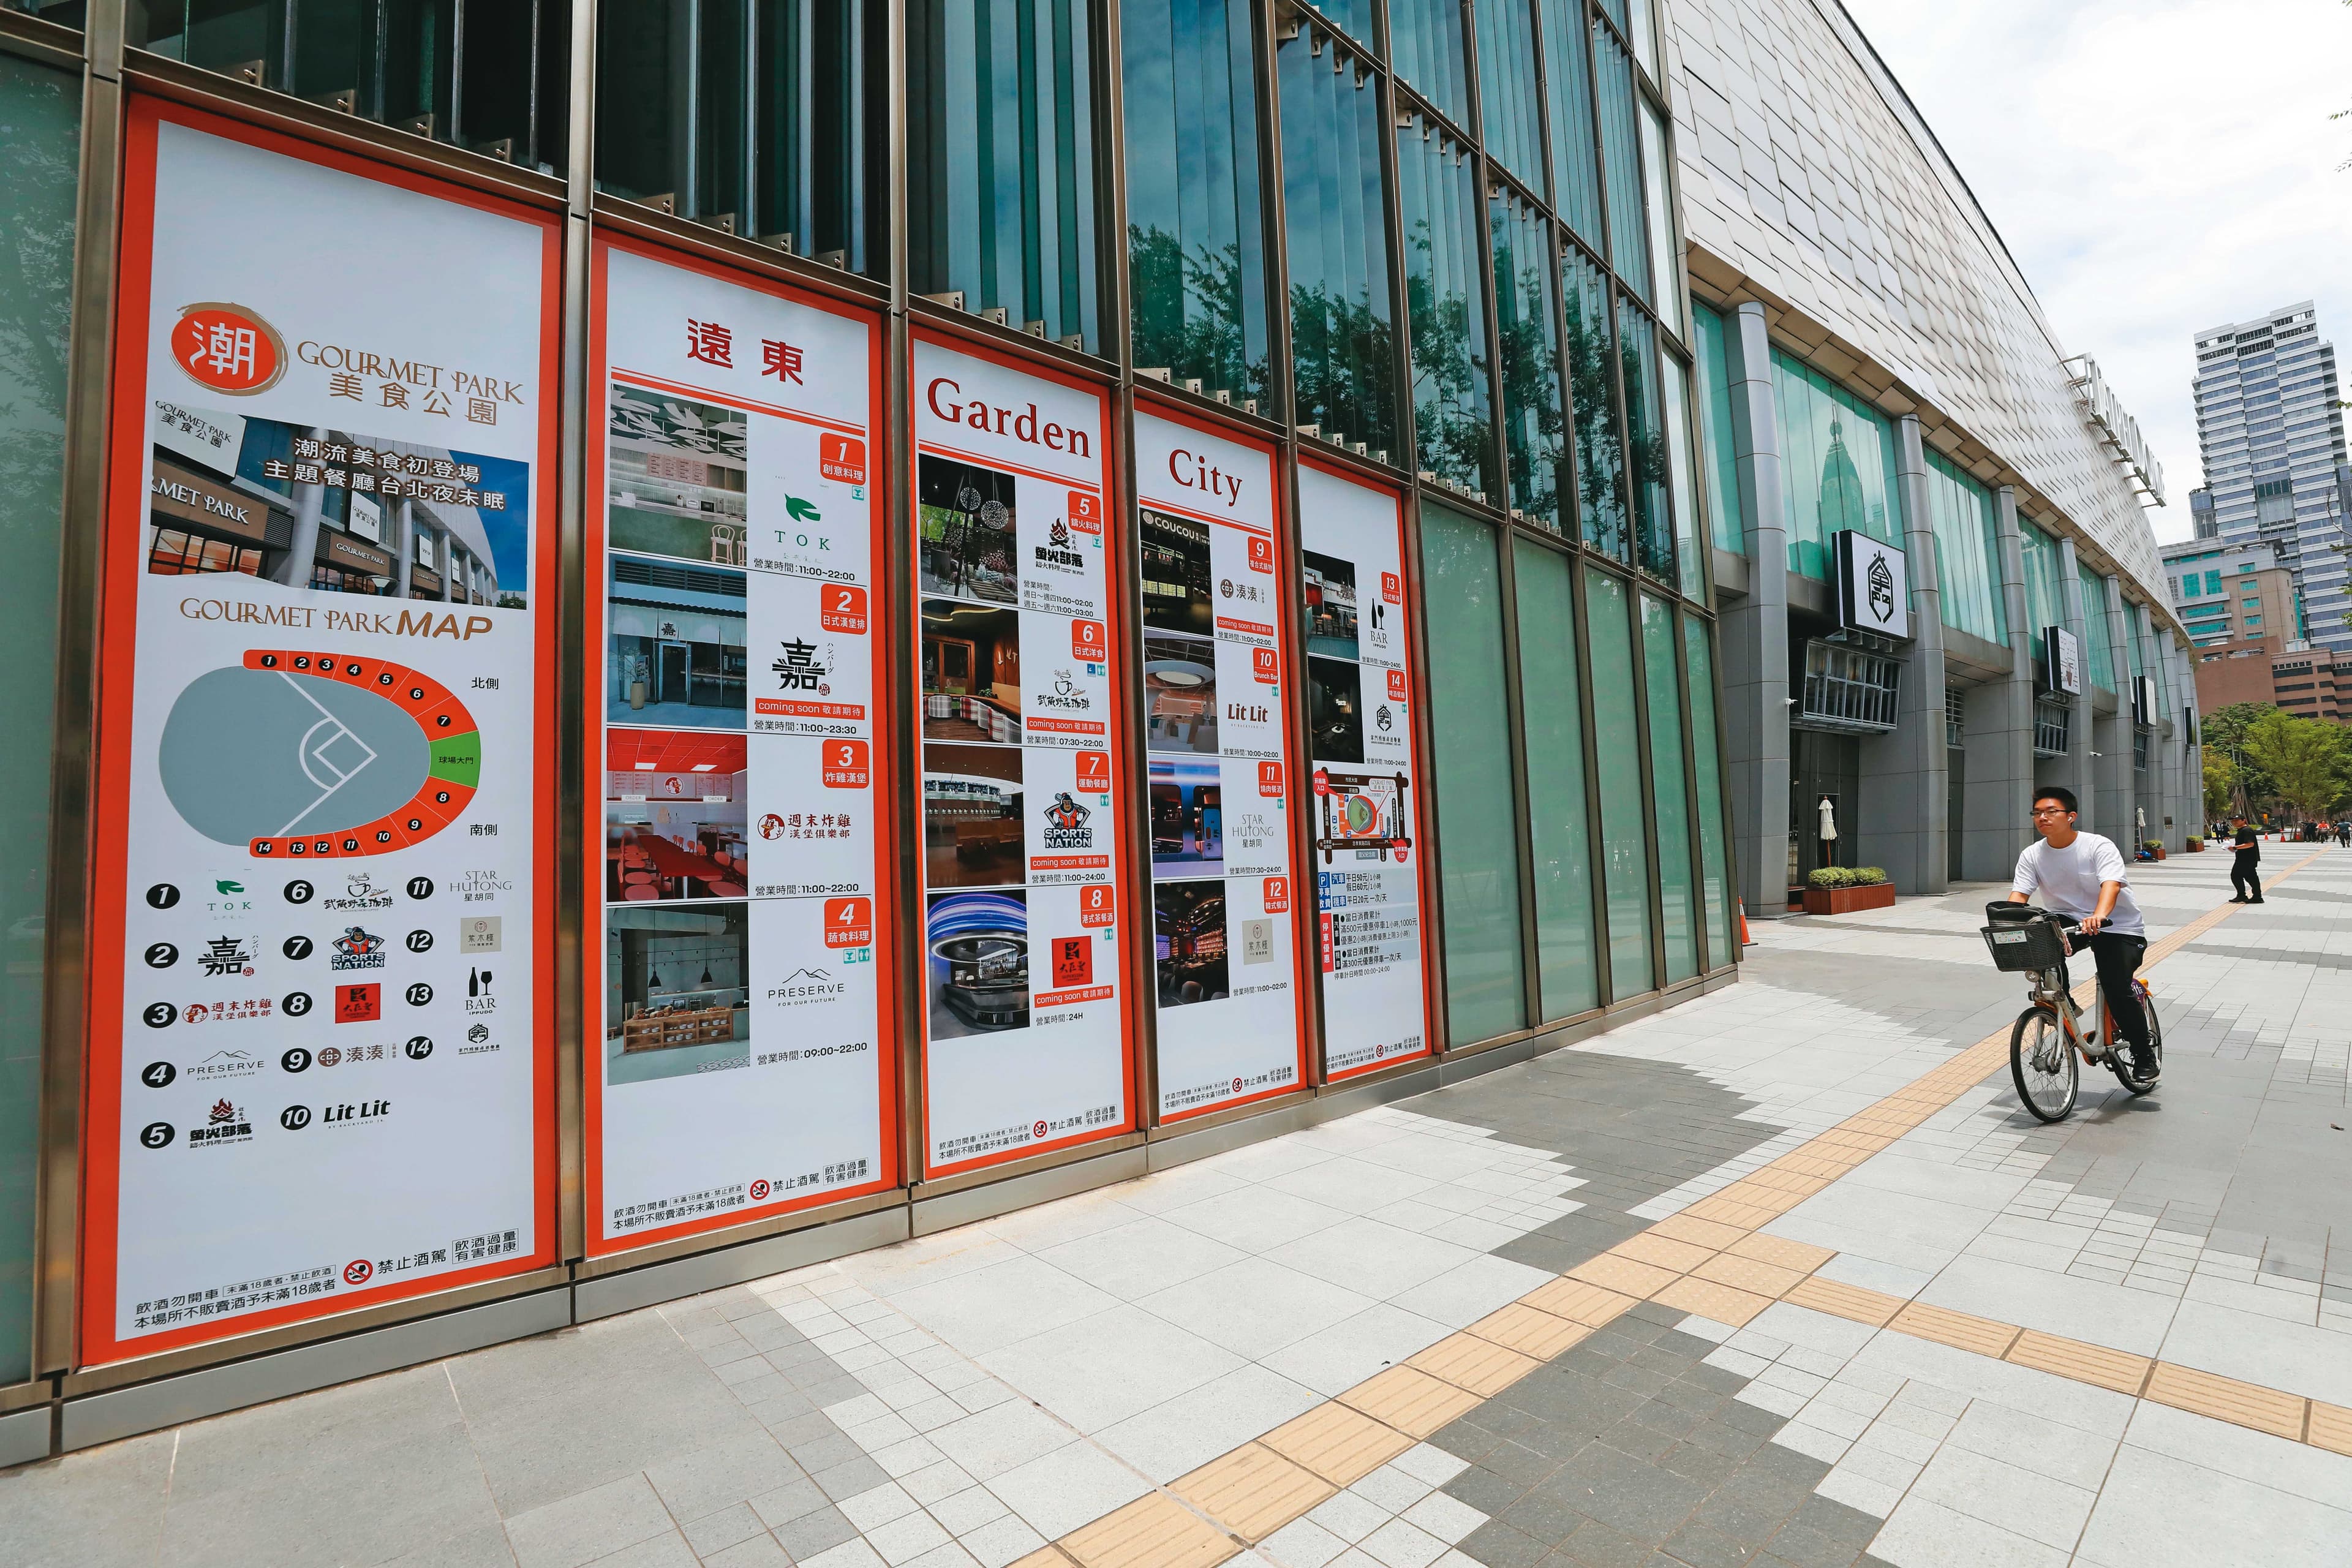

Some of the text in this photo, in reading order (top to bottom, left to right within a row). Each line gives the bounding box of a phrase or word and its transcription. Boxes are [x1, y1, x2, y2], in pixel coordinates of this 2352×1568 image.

[191, 321, 256, 380] 潮
[687, 318, 804, 386] 遠東
[297, 341, 524, 405] GOURMET PARK
[329, 372, 497, 425] 美食公園
[156, 401, 232, 443] GOURMET PARK
[927, 377, 1091, 459] Garden
[161, 413, 222, 448] 美食公園
[295, 438, 480, 483] 潮流美食初登場
[839, 442, 848, 462] 1
[823, 462, 863, 481] 創意料理
[1169, 449, 1242, 507] City
[265, 461, 504, 510] 主題餐廳台北夜未眠
[204, 493, 249, 526] PARK
[1079, 498, 1090, 515] 5
[1155, 517, 1194, 539] COUCOU
[775, 530, 830, 551] TOK
[336, 543, 385, 565] GOURMET PARK
[1035, 546, 1084, 568] 螢火部落
[1256, 542, 1264, 557] 9
[1387, 577, 1395, 589] 13
[836, 591, 853, 611] 2
[1236, 584, 1257, 601] 湊湊
[180, 598, 493, 641] GOURMET PARK MAP
[823, 615, 865, 630] 日式漢堡排
[1218, 620, 1237, 628] coming
[661, 622, 676, 636] 嘉
[1083, 625, 1093, 642] 6
[1370, 631, 1388, 644] BAR
[1075, 646, 1103, 658] 日式洋食
[1260, 652, 1272, 666] 10
[772, 636, 826, 690] 嘉
[471, 677, 499, 690] 北側
[1392, 674, 1400, 687] 14
[759, 701, 794, 714] coming
[823, 706, 861, 716] 敬請期待
[1227, 703, 1268, 722] Lit Lit
[1029, 720, 1054, 729] coming
[1074, 722, 1102, 732] 敬請期待
[438, 756, 474, 764] 球場大門
[838, 745, 853, 767] 3
[1089, 756, 1100, 774] 7
[1266, 766, 1275, 780] 11
[825, 772, 867, 783] 炸雞漢堡
[1079, 778, 1108, 788] 運動餐廳
[788, 813, 851, 827] 週末炸雞
[1242, 814, 1264, 825] STAR
[470, 824, 497, 836] 南側
[790, 829, 850, 839] 漢堡俱樂部
[1044, 828, 1092, 838] SPORTS
[1232, 826, 1273, 837] HUTONG
[1045, 837, 1092, 848] NATION
[1243, 839, 1262, 848] 星胡同
[1033, 859, 1058, 867] coming
[1078, 857, 1106, 865] 敬請期待
[465, 870, 498, 881] STAR
[292, 883, 307, 900] 6
[413, 881, 428, 895] 11
[450, 881, 512, 892] HUTONG
[1270, 882, 1281, 897] 12
[159, 887, 168, 904] 1
[464, 893, 494, 902] 星胡同
[1091, 889, 1102, 907] 8
[207, 902, 252, 911] TOK
[839, 903, 854, 925] 4
[1082, 913, 1113, 924] 港式茶餐酒
[410, 934, 430, 948] 12
[827, 930, 869, 943] 蔬食料理
[153, 946, 171, 963] 2
[198, 935, 250, 977] 嘉
[290, 939, 306, 956] 7
[331, 952, 385, 963] SPORTS
[332, 960, 385, 970] NATION
[410, 987, 429, 1002] 13
[768, 983, 845, 999] PRESERVE
[1036, 995, 1062, 1005] coming
[1083, 988, 1110, 998] 敬請期待
[211, 998, 273, 1012] 週末炸雞
[289, 995, 305, 1013] 8
[465, 998, 497, 1011] BAR
[151, 1005, 168, 1023] 3
[213, 1010, 271, 1021] 漢堡俱樂部
[346, 1045, 383, 1063] 湊湊
[409, 1040, 430, 1055] 14
[187, 1060, 265, 1075] PRESERVE
[288, 1052, 304, 1069] 9
[149, 1065, 167, 1083] 4
[1244, 1074, 1267, 1087] 禁止酒駕
[285, 1109, 307, 1126] 10
[323, 1099, 391, 1123] Lit Lit
[190, 1123, 252, 1142] 螢火部落
[1050, 1117, 1082, 1131] 禁止酒駕
[148, 1126, 167, 1145] 5
[825, 1159, 867, 1175] 飲酒過量
[825, 1167, 868, 1183] 有害健康
[773, 1172, 820, 1193] 禁止酒駕
[613, 1194, 745, 1230] 本場所不販賣酒予未滿18歲者
[614, 1200, 668, 1218] 飲酒勿開車
[455, 1231, 516, 1251] 飲酒過量
[455, 1242, 516, 1262] 有害健康
[378, 1249, 446, 1275] 禁止酒駕
[134, 1278, 336, 1329] 本場所不販賣酒予未滿18歲者
[136, 1289, 219, 1314] 飲酒勿開車
